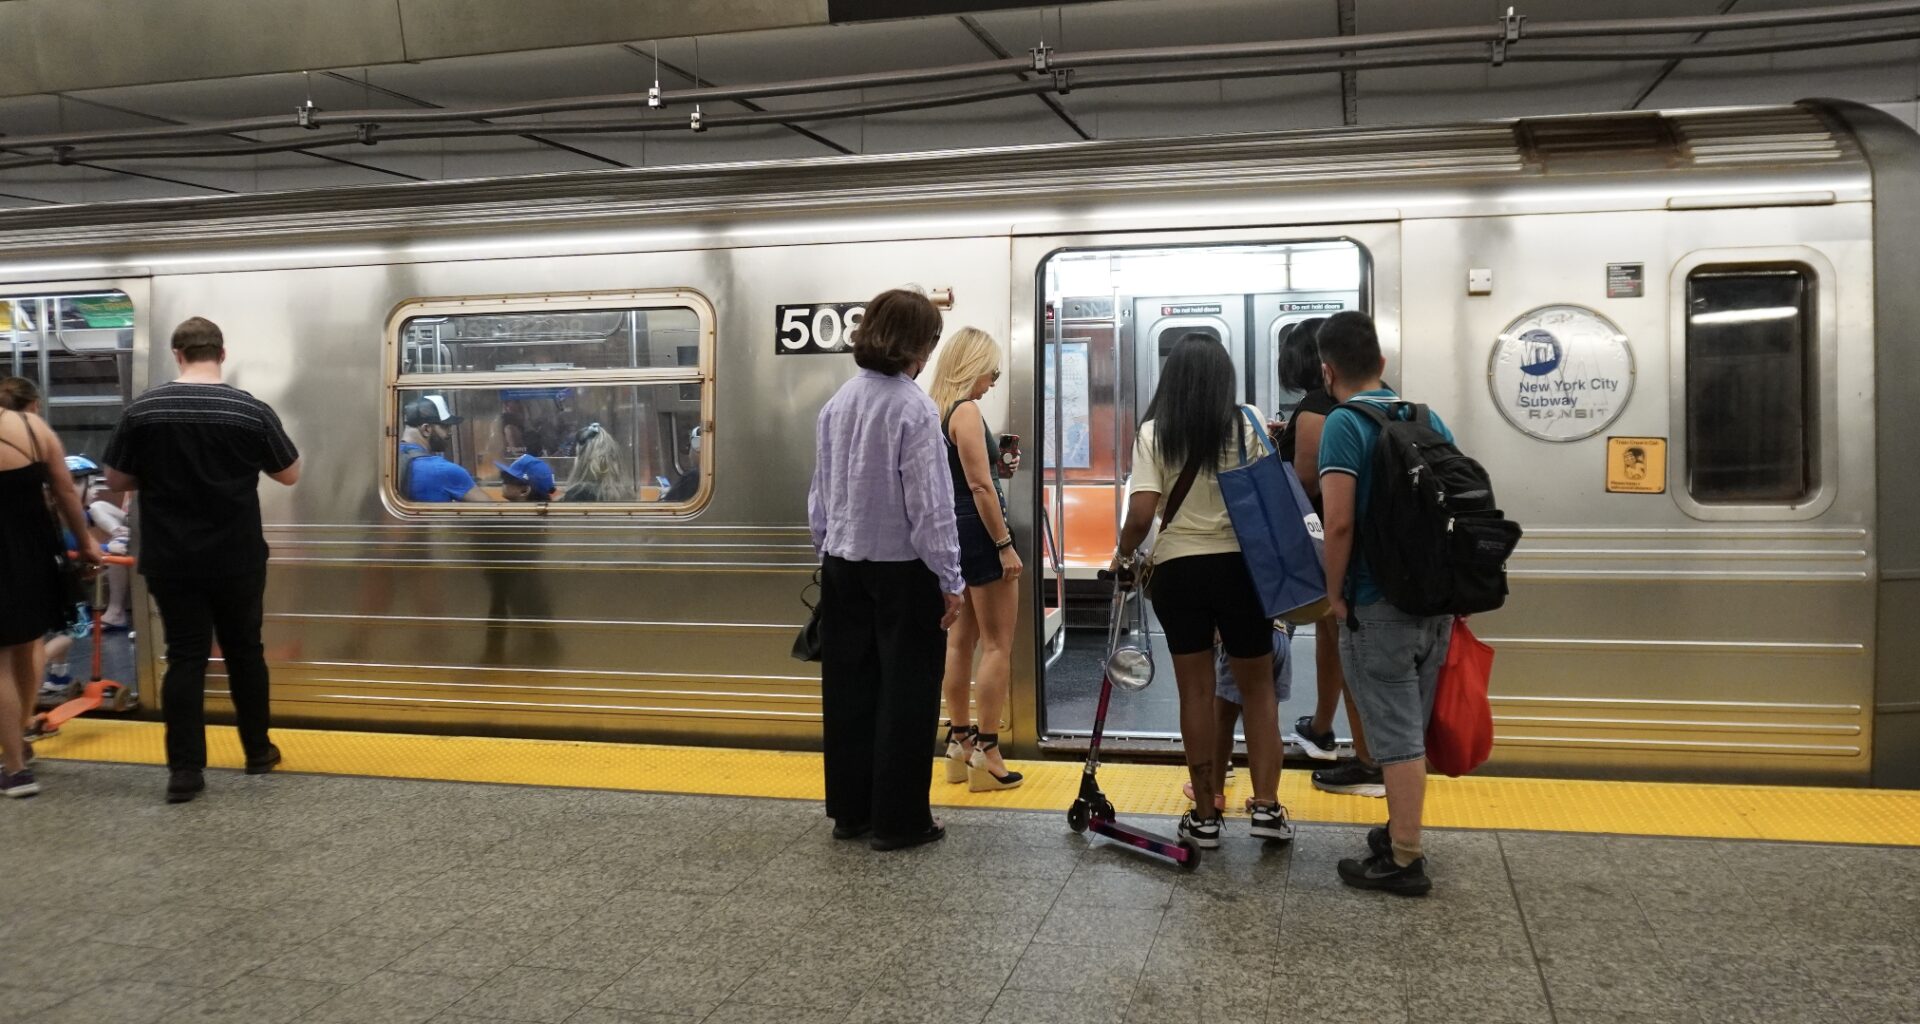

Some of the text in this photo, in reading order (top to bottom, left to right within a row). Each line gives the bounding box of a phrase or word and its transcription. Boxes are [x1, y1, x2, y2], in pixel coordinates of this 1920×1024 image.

[1519, 378, 1618, 393] New York City
[1520, 396, 1578, 408] Subway
